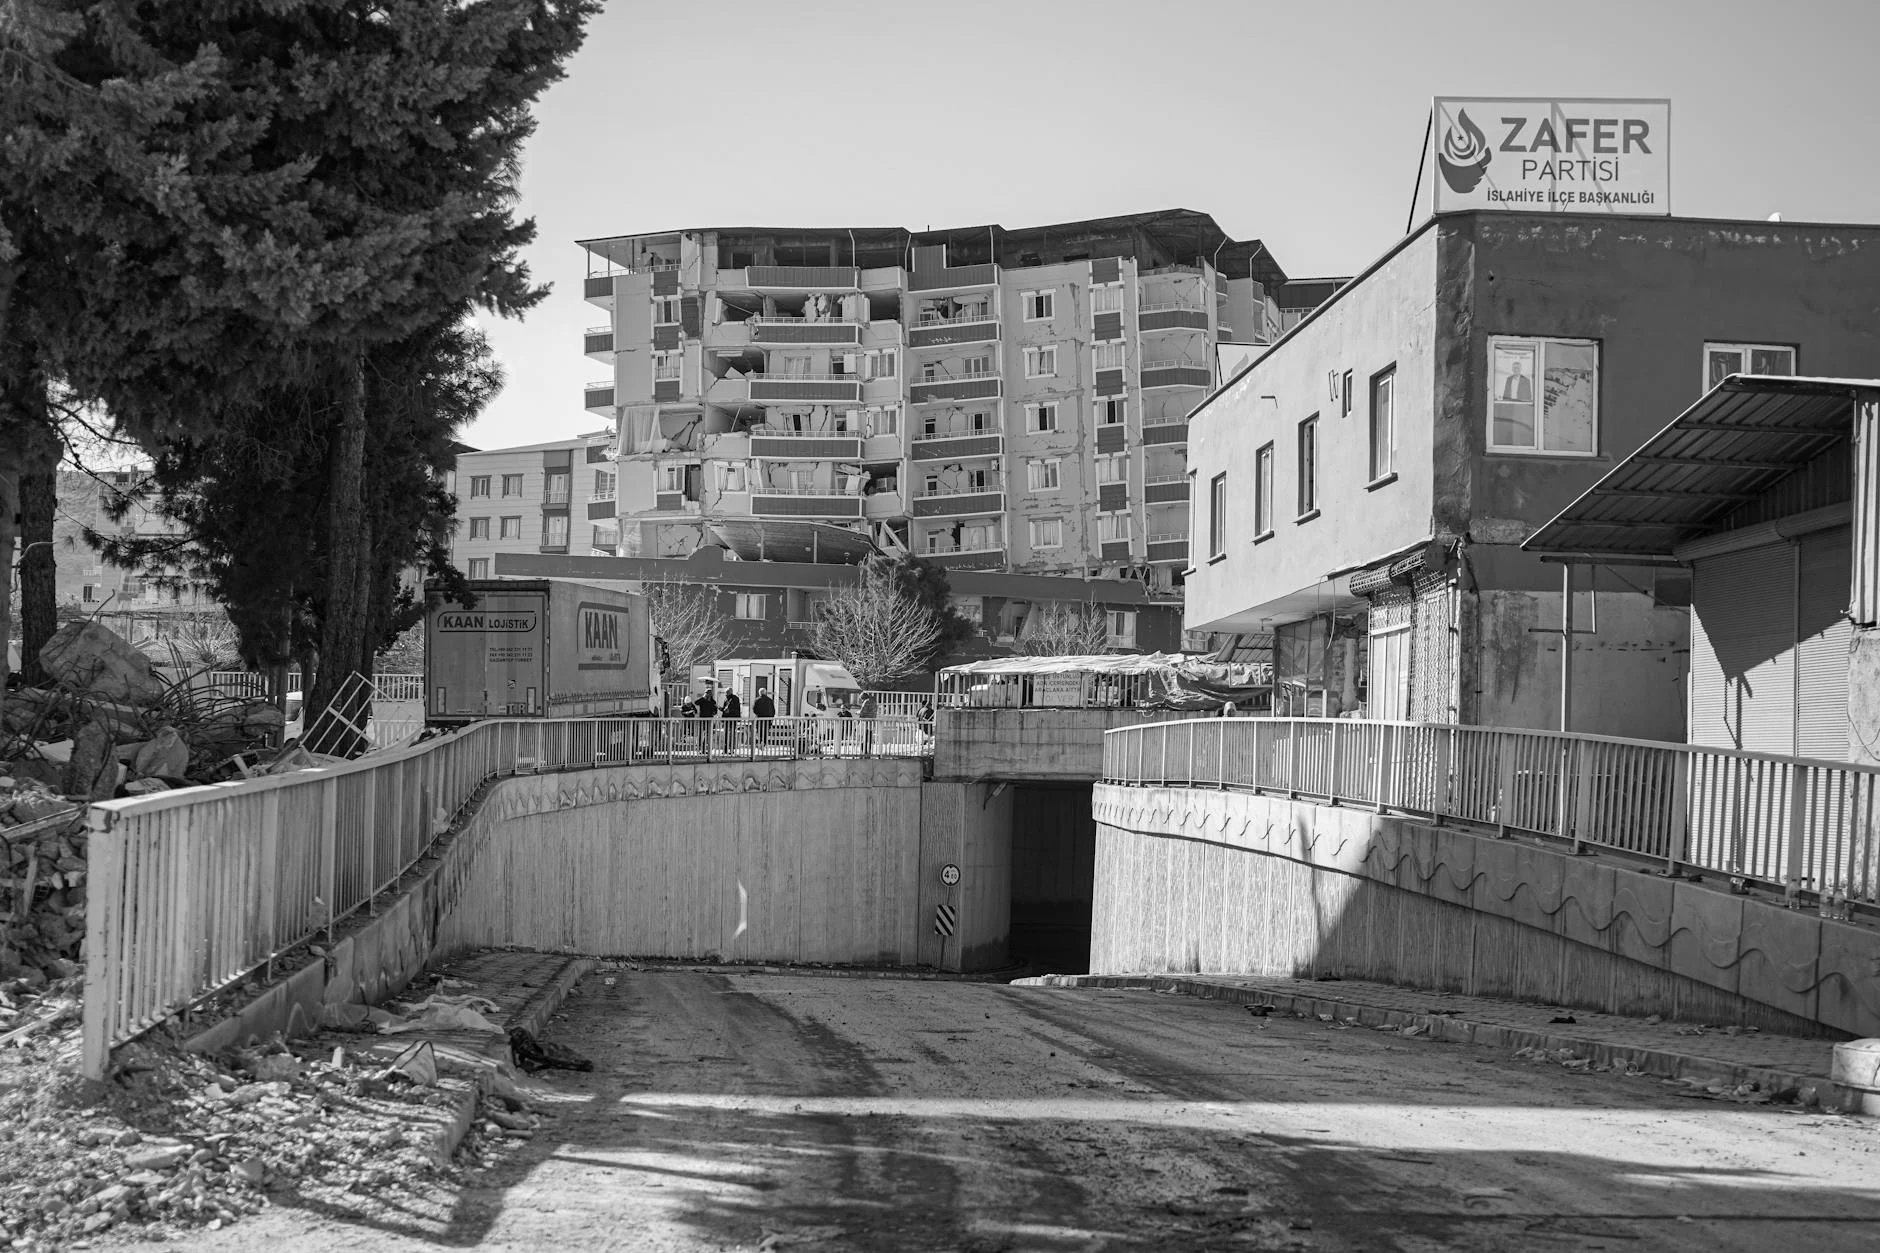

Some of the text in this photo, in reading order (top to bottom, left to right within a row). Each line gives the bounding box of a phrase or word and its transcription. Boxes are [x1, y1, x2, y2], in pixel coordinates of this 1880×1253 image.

[1499, 117, 1653, 154] ZAFER
[1522, 156, 1619, 181] PARTİSİ
[1487, 187, 1655, 206] İSLAHİYE İLÇE BAŞKANLIĞI
[444, 616, 483, 628] KAAN
[585, 611, 618, 649] KAAN
